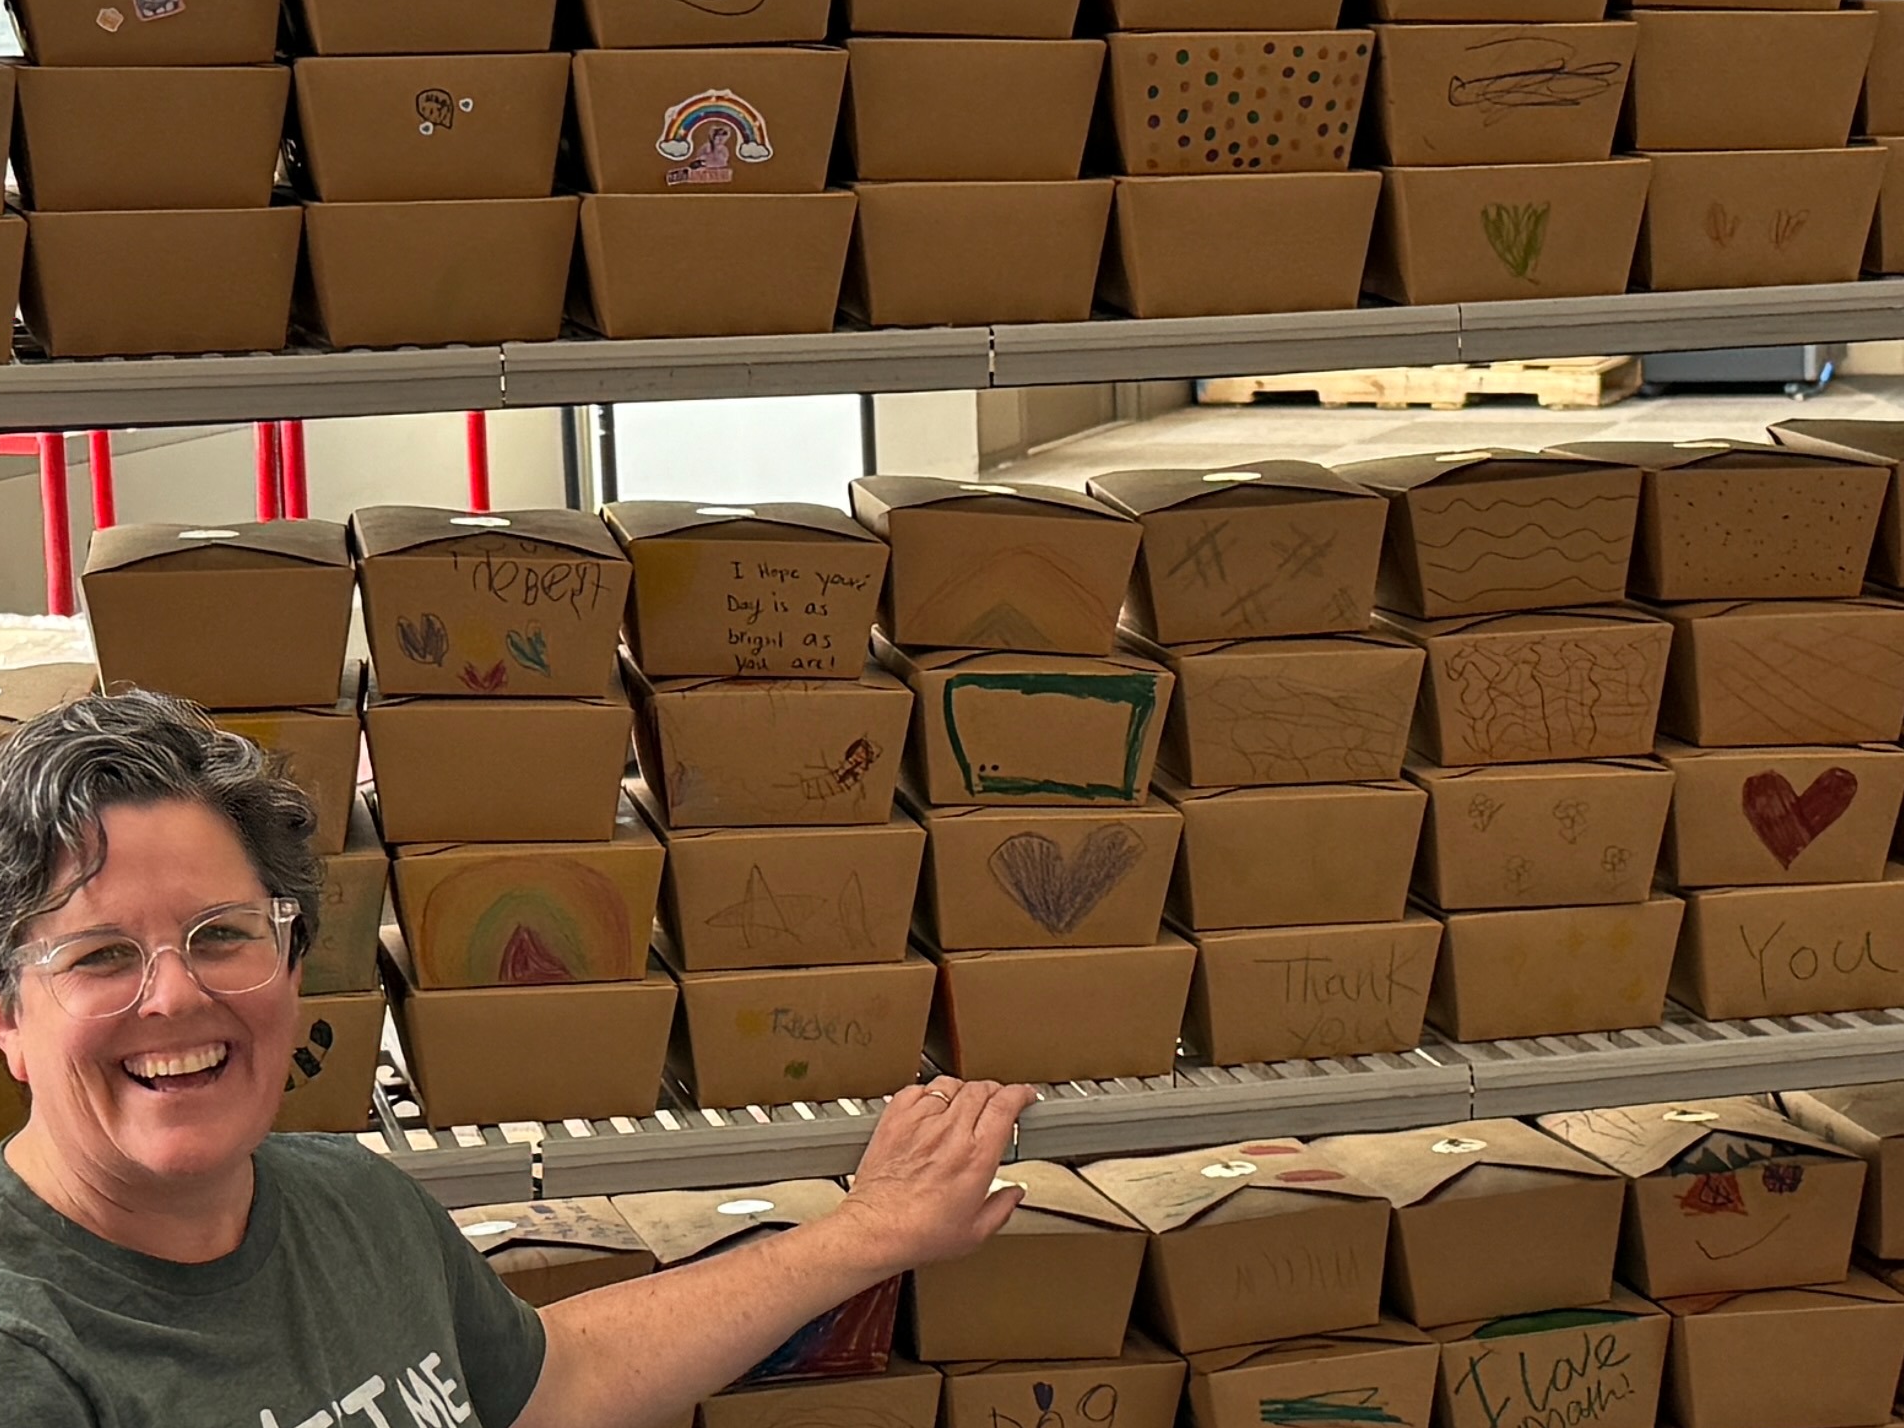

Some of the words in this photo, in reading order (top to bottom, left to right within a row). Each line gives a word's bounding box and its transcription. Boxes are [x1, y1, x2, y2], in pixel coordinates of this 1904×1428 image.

[730, 560, 744, 580] I
[771, 590, 789, 613] is
[804, 601, 828, 617] as
[802, 632, 832, 650] as
[1253, 942, 1423, 1006] Thank
